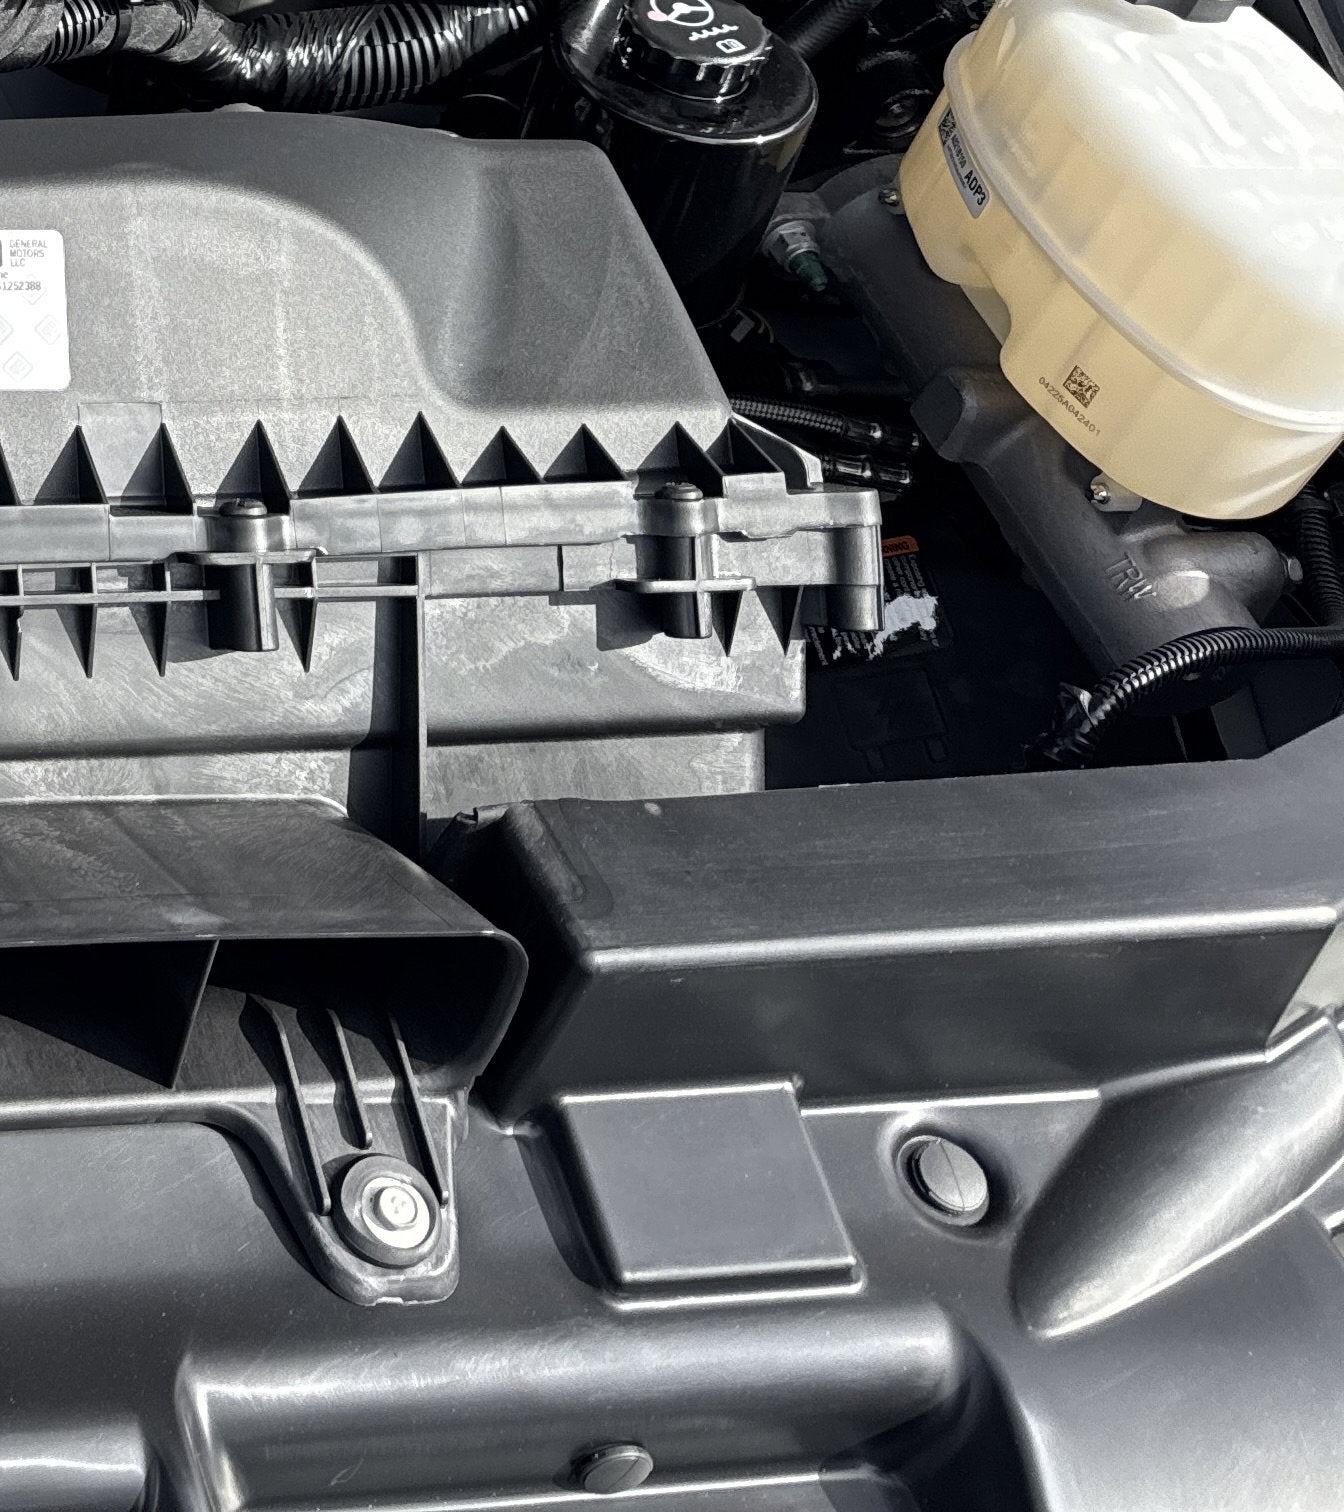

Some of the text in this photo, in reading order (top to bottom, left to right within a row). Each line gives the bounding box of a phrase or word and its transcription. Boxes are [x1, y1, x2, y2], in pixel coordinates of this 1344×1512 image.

[964, 170, 986, 205] ADP3
[9, 240, 48, 248] GENERAL
[1038, 376, 1101, 437] 04225A042401
